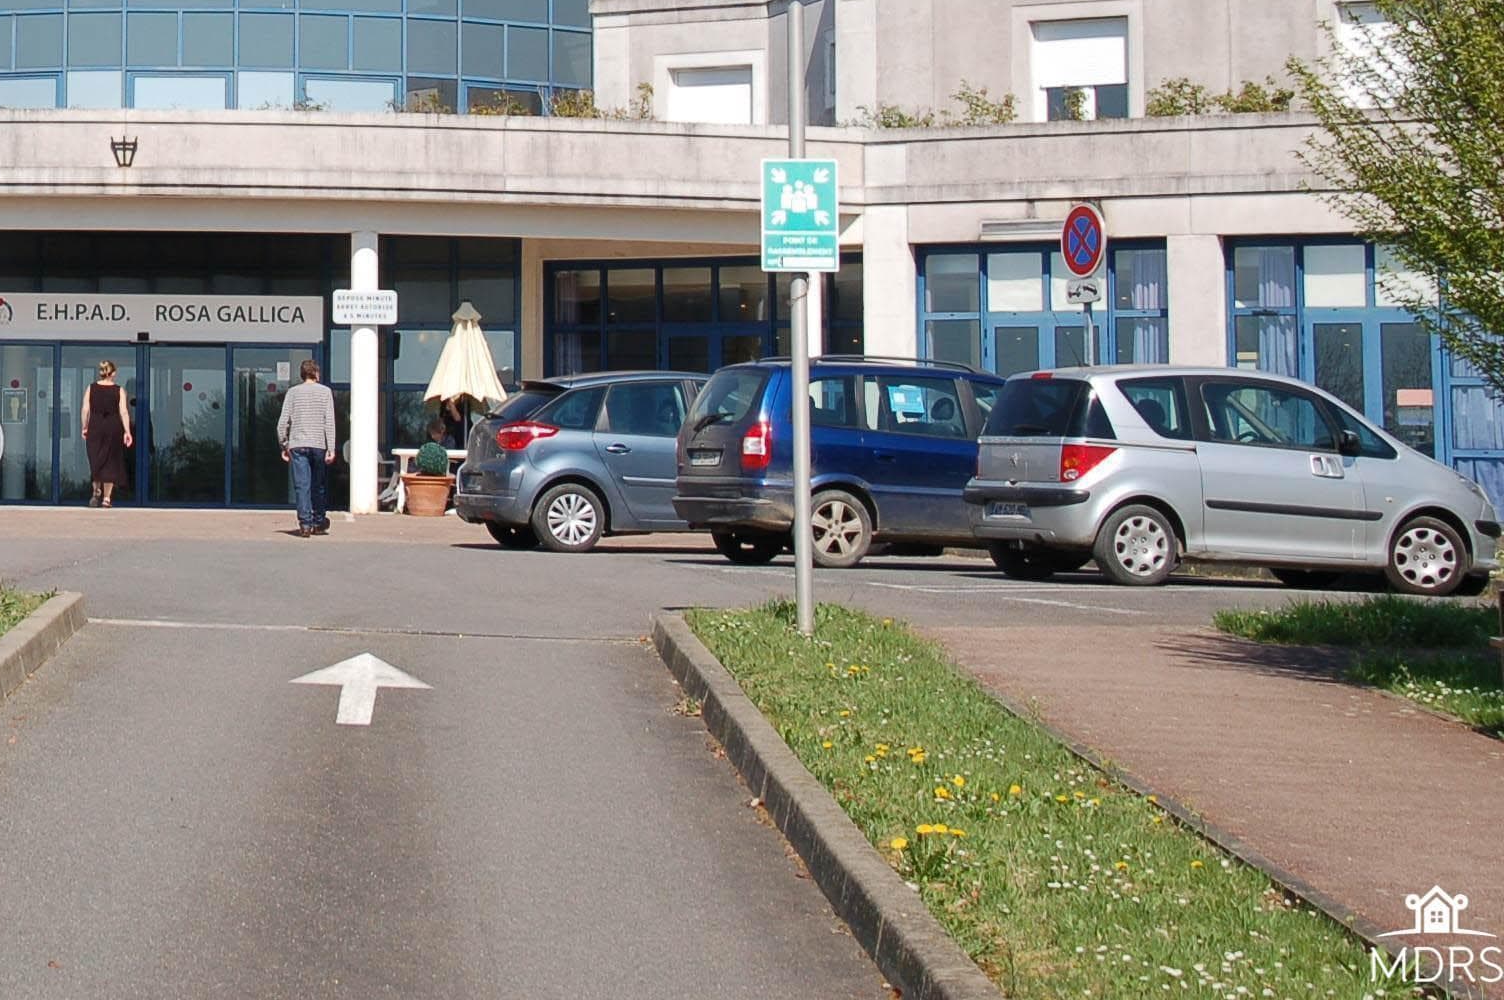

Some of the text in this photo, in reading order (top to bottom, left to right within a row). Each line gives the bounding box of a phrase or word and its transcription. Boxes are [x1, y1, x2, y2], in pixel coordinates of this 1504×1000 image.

[36, 303, 305, 323] E.H.P.A.D. ROSA GALLICA
